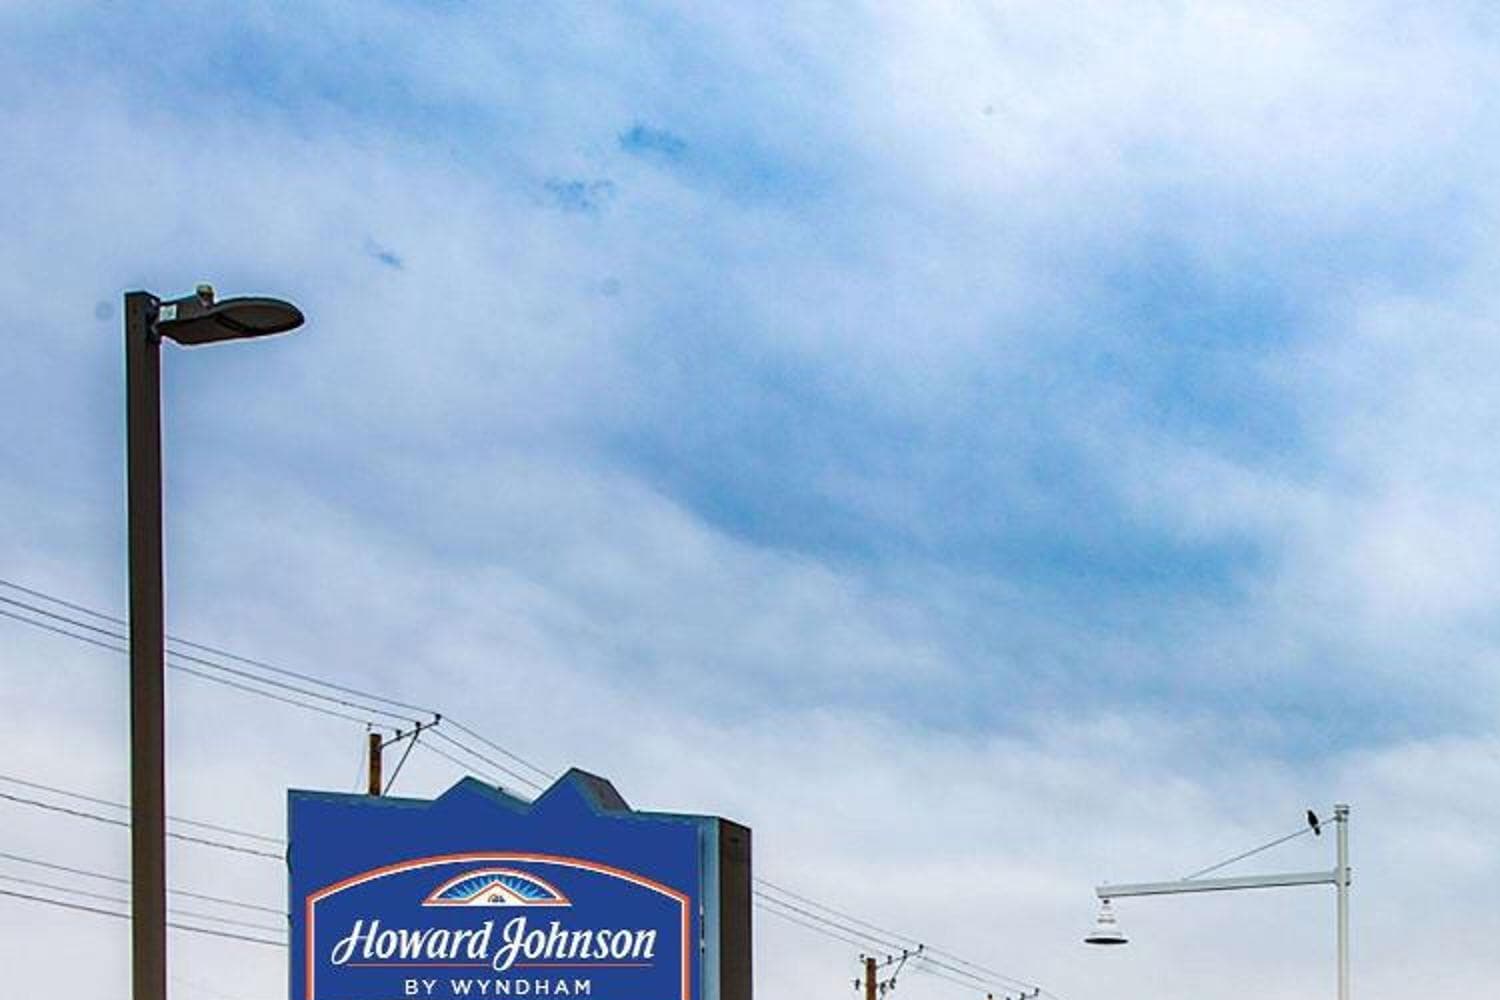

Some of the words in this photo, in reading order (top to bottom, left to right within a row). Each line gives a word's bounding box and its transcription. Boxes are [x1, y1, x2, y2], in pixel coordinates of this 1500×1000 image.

[331, 919, 493, 965] Howard
[492, 916, 657, 971] Johnson
[405, 980, 437, 995] BY
[451, 979, 592, 995] WYNDHAM
